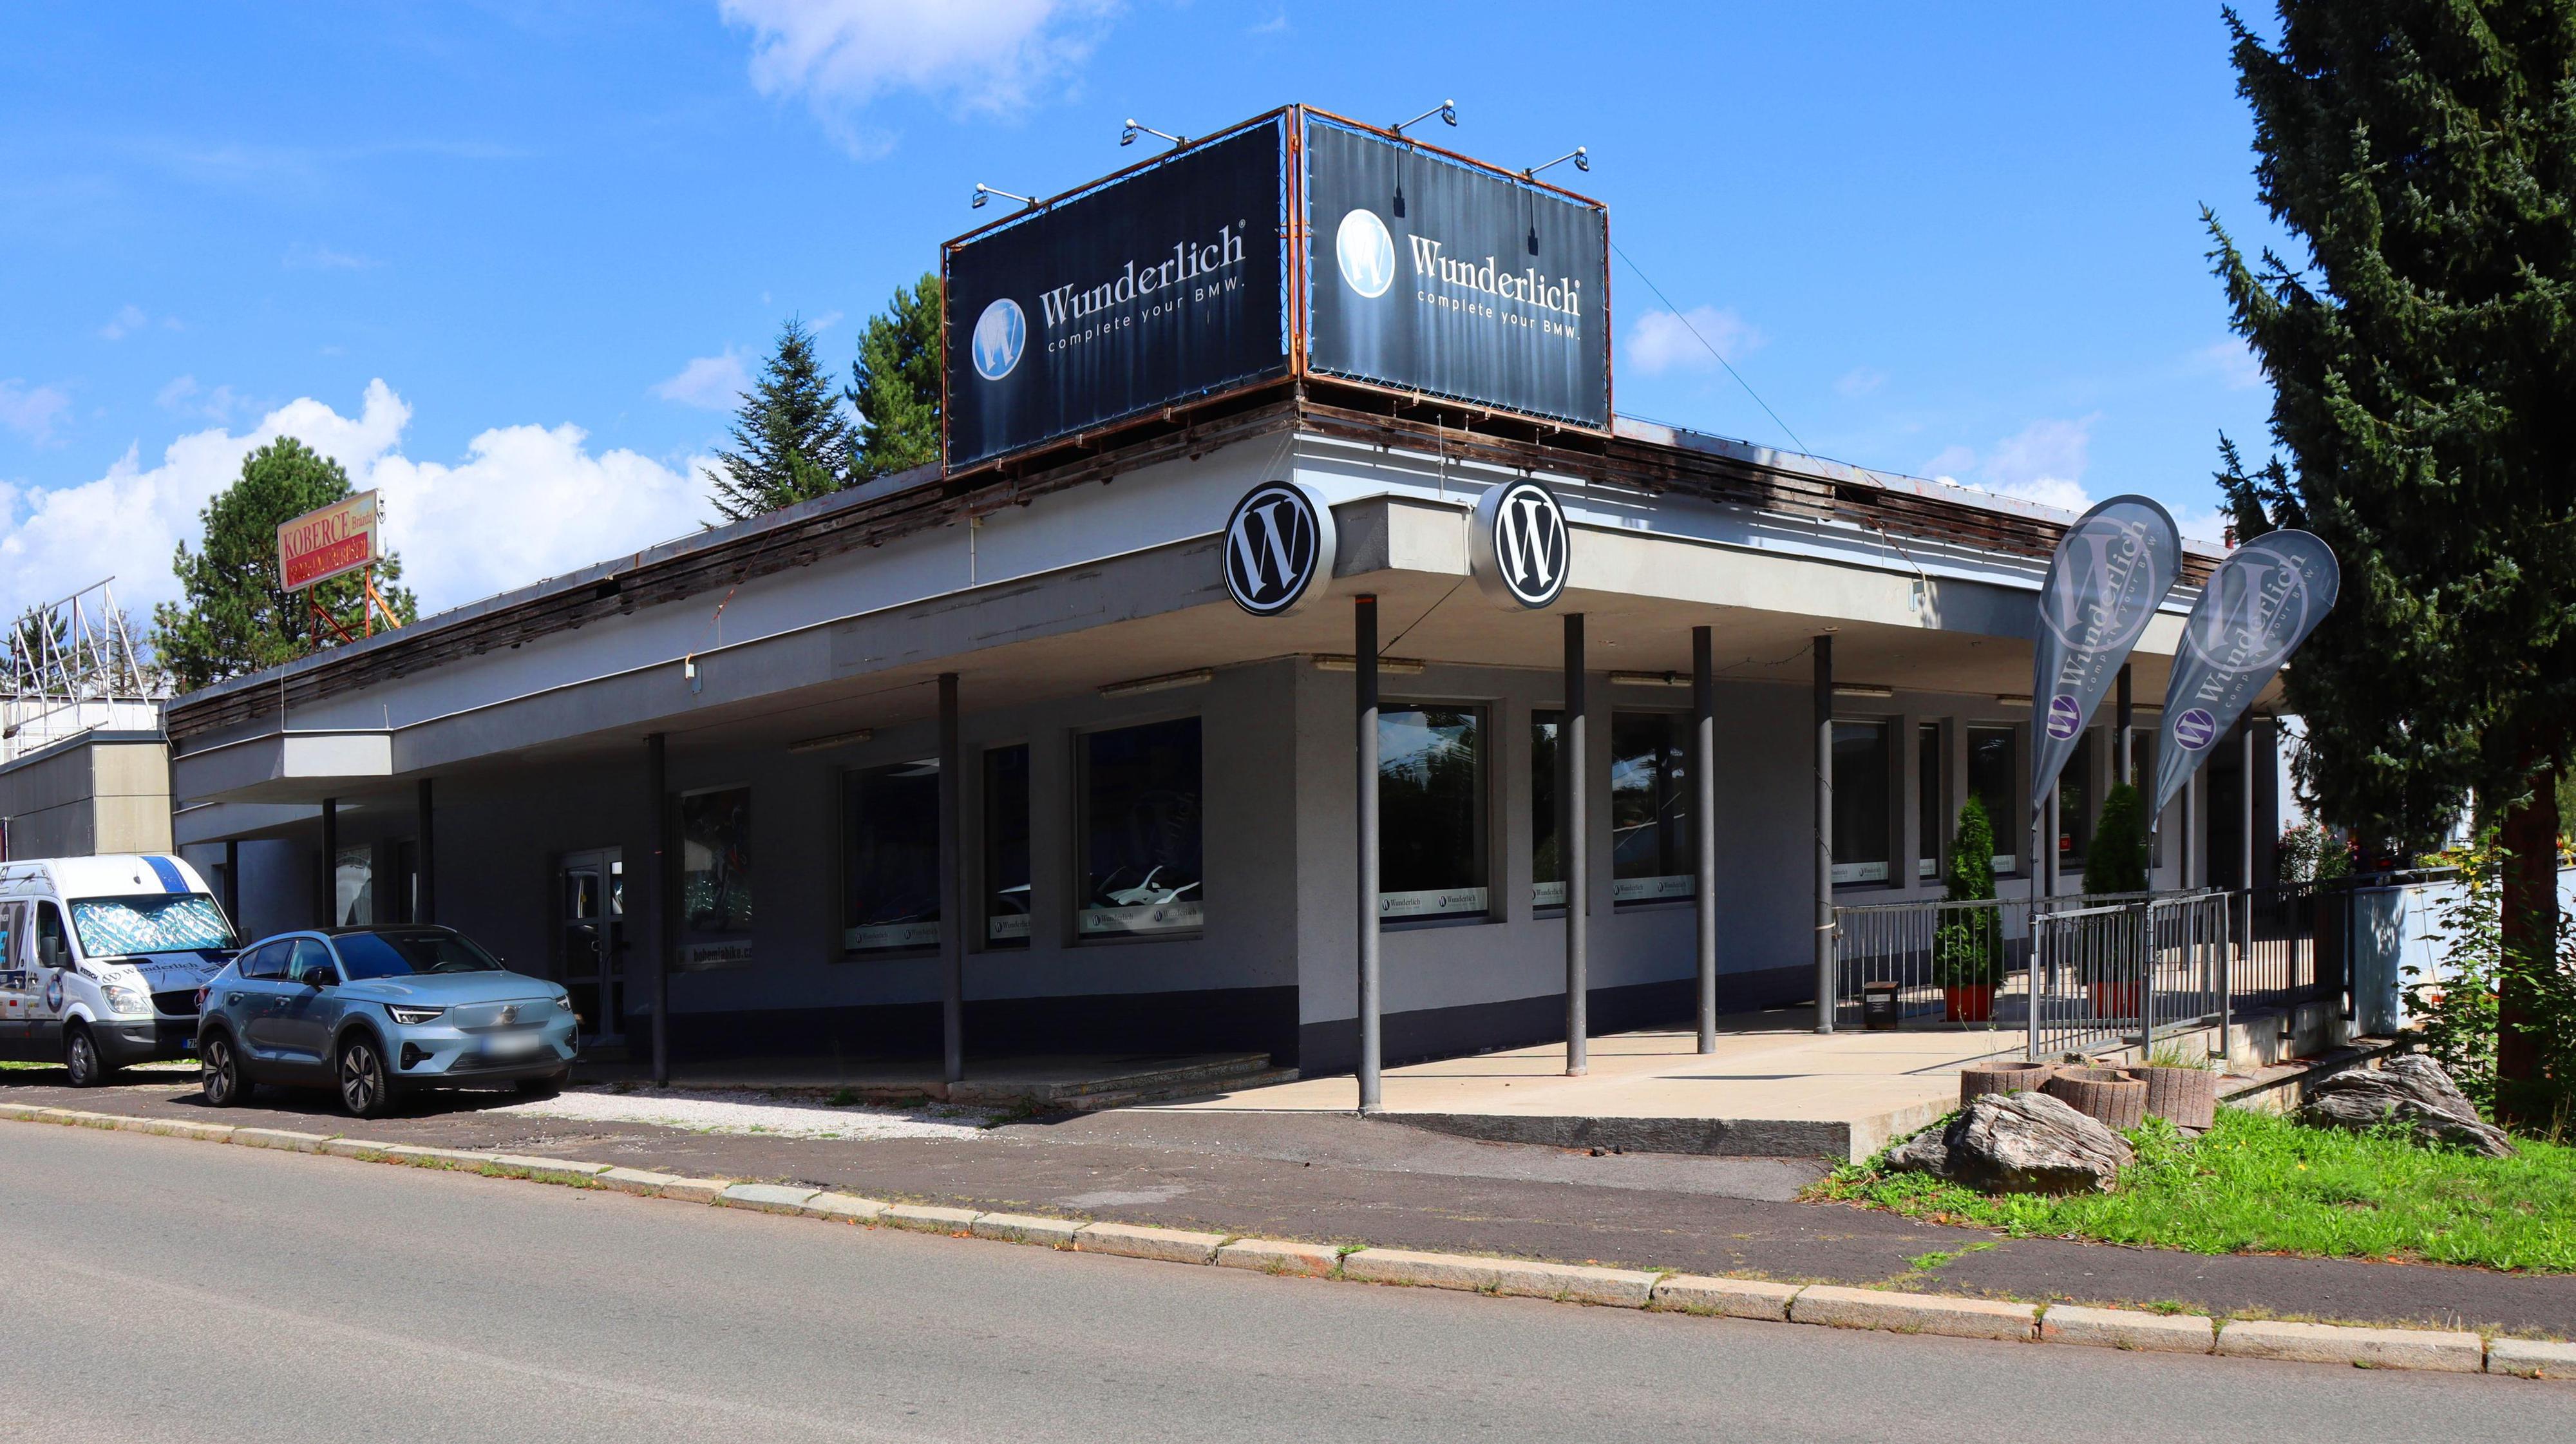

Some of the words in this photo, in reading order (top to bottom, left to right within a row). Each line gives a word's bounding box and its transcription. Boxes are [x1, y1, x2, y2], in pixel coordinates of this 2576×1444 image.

[1048, 314, 1131, 352] complete
[1141, 296, 1183, 323] your
[1195, 276, 1245, 302] BMW.
[1417, 290, 1493, 318] complete
[1501, 311, 1535, 329] your
[1543, 319, 1580, 341] BMW.
[284, 511, 350, 559] KOBERCE
[1230, 496, 1302, 599] W
[1501, 496, 1561, 588] W
[2058, 520, 2148, 687] Wunderlich
[2120, 577, 2139, 613] your
[2195, 555, 2307, 701] Wunderlich
[2268, 606, 2291, 639] your
[1101, 913, 1133, 923] Wunderlich
[1390, 898, 1421, 907] Wunderlich
[1447, 894, 1476, 903] Wunderlich
